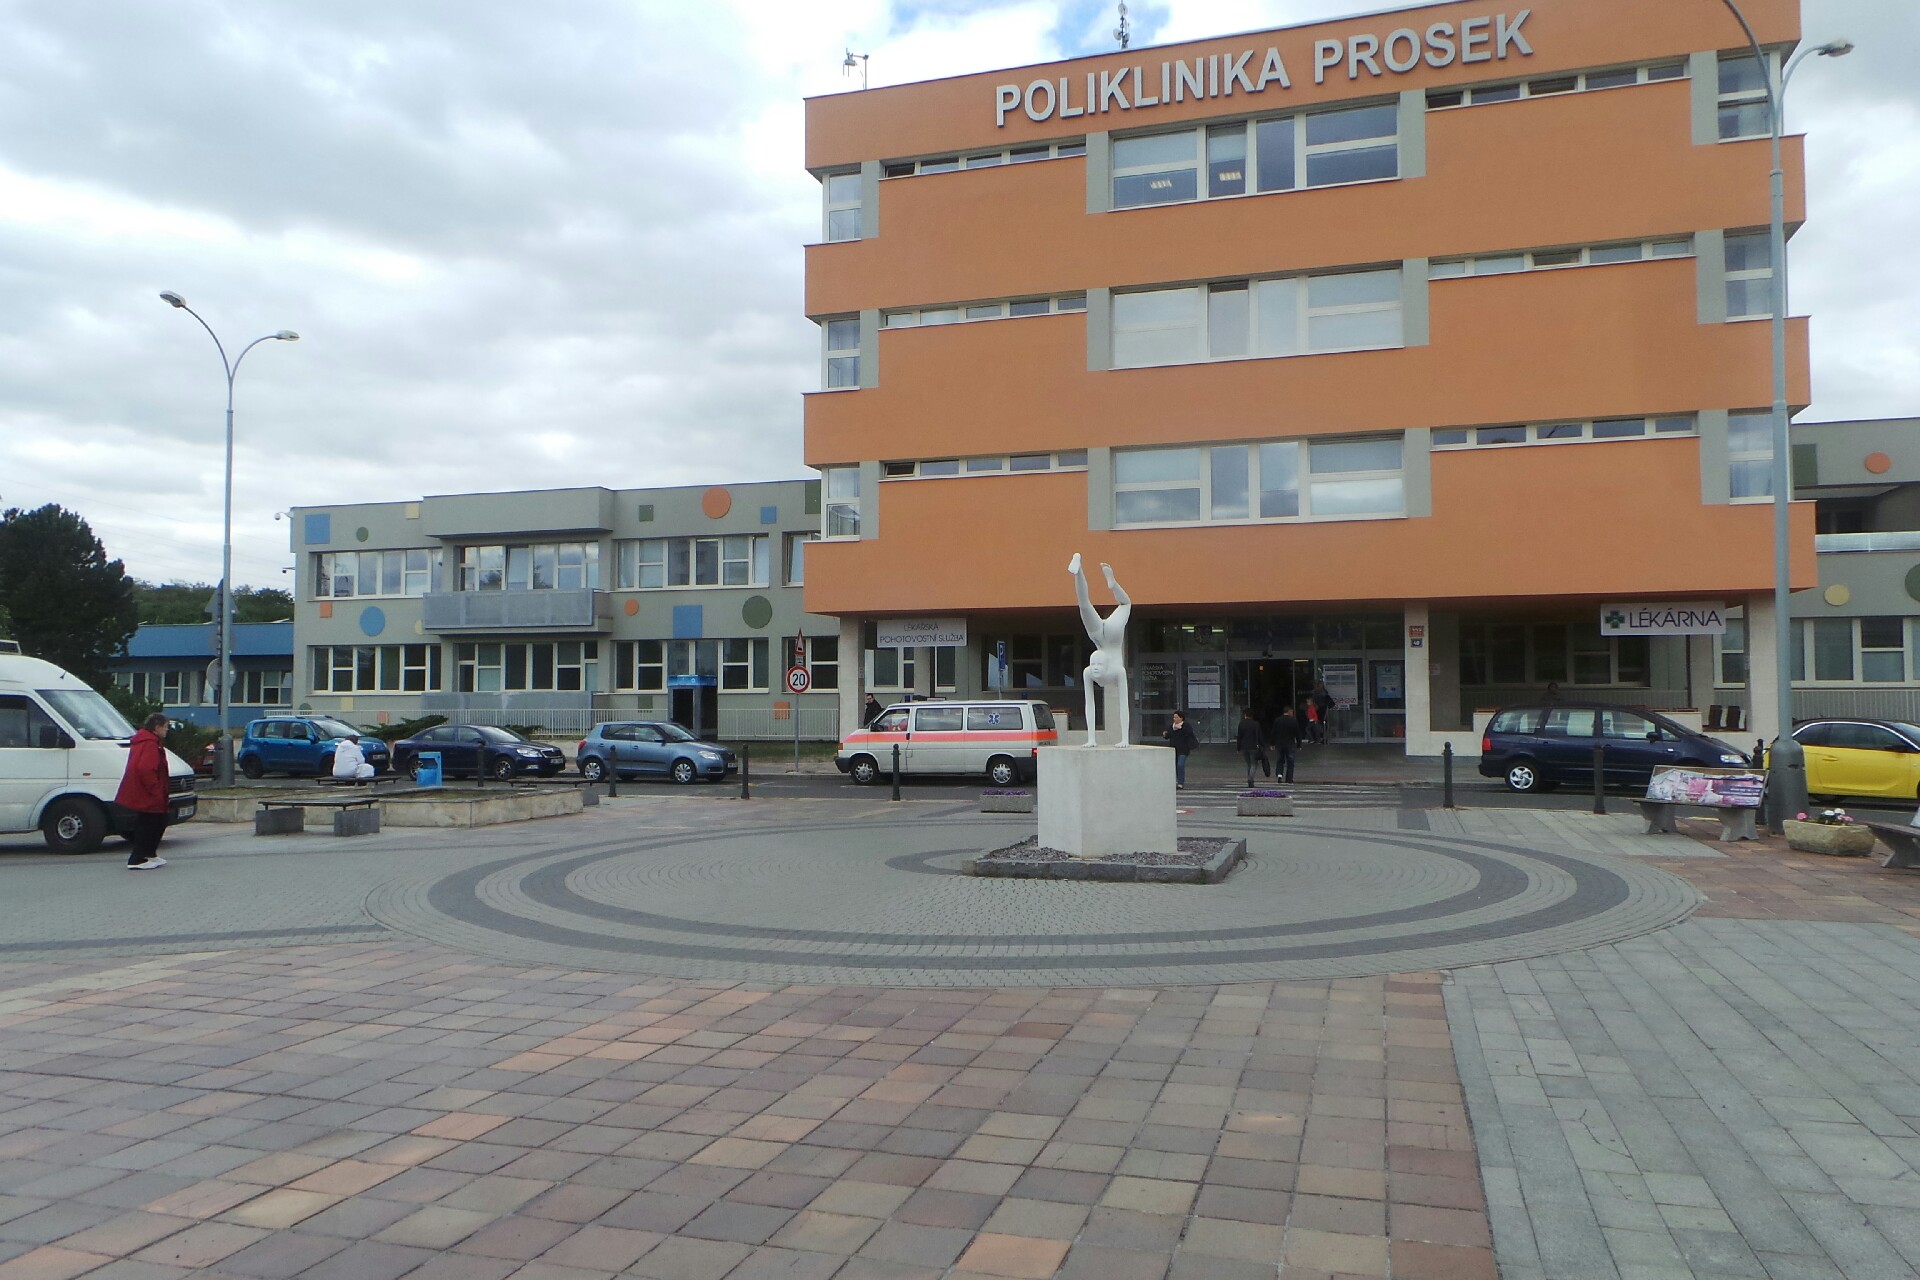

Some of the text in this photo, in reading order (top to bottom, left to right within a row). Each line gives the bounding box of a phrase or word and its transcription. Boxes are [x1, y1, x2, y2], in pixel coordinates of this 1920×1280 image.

[996, 9, 1533, 126] POLIKLINIKA PROSEK
[1629, 607, 1722, 628] LÉKÁRNA
[939, 633, 964, 642] SLUŽBA
[792, 673, 806, 687] 20
